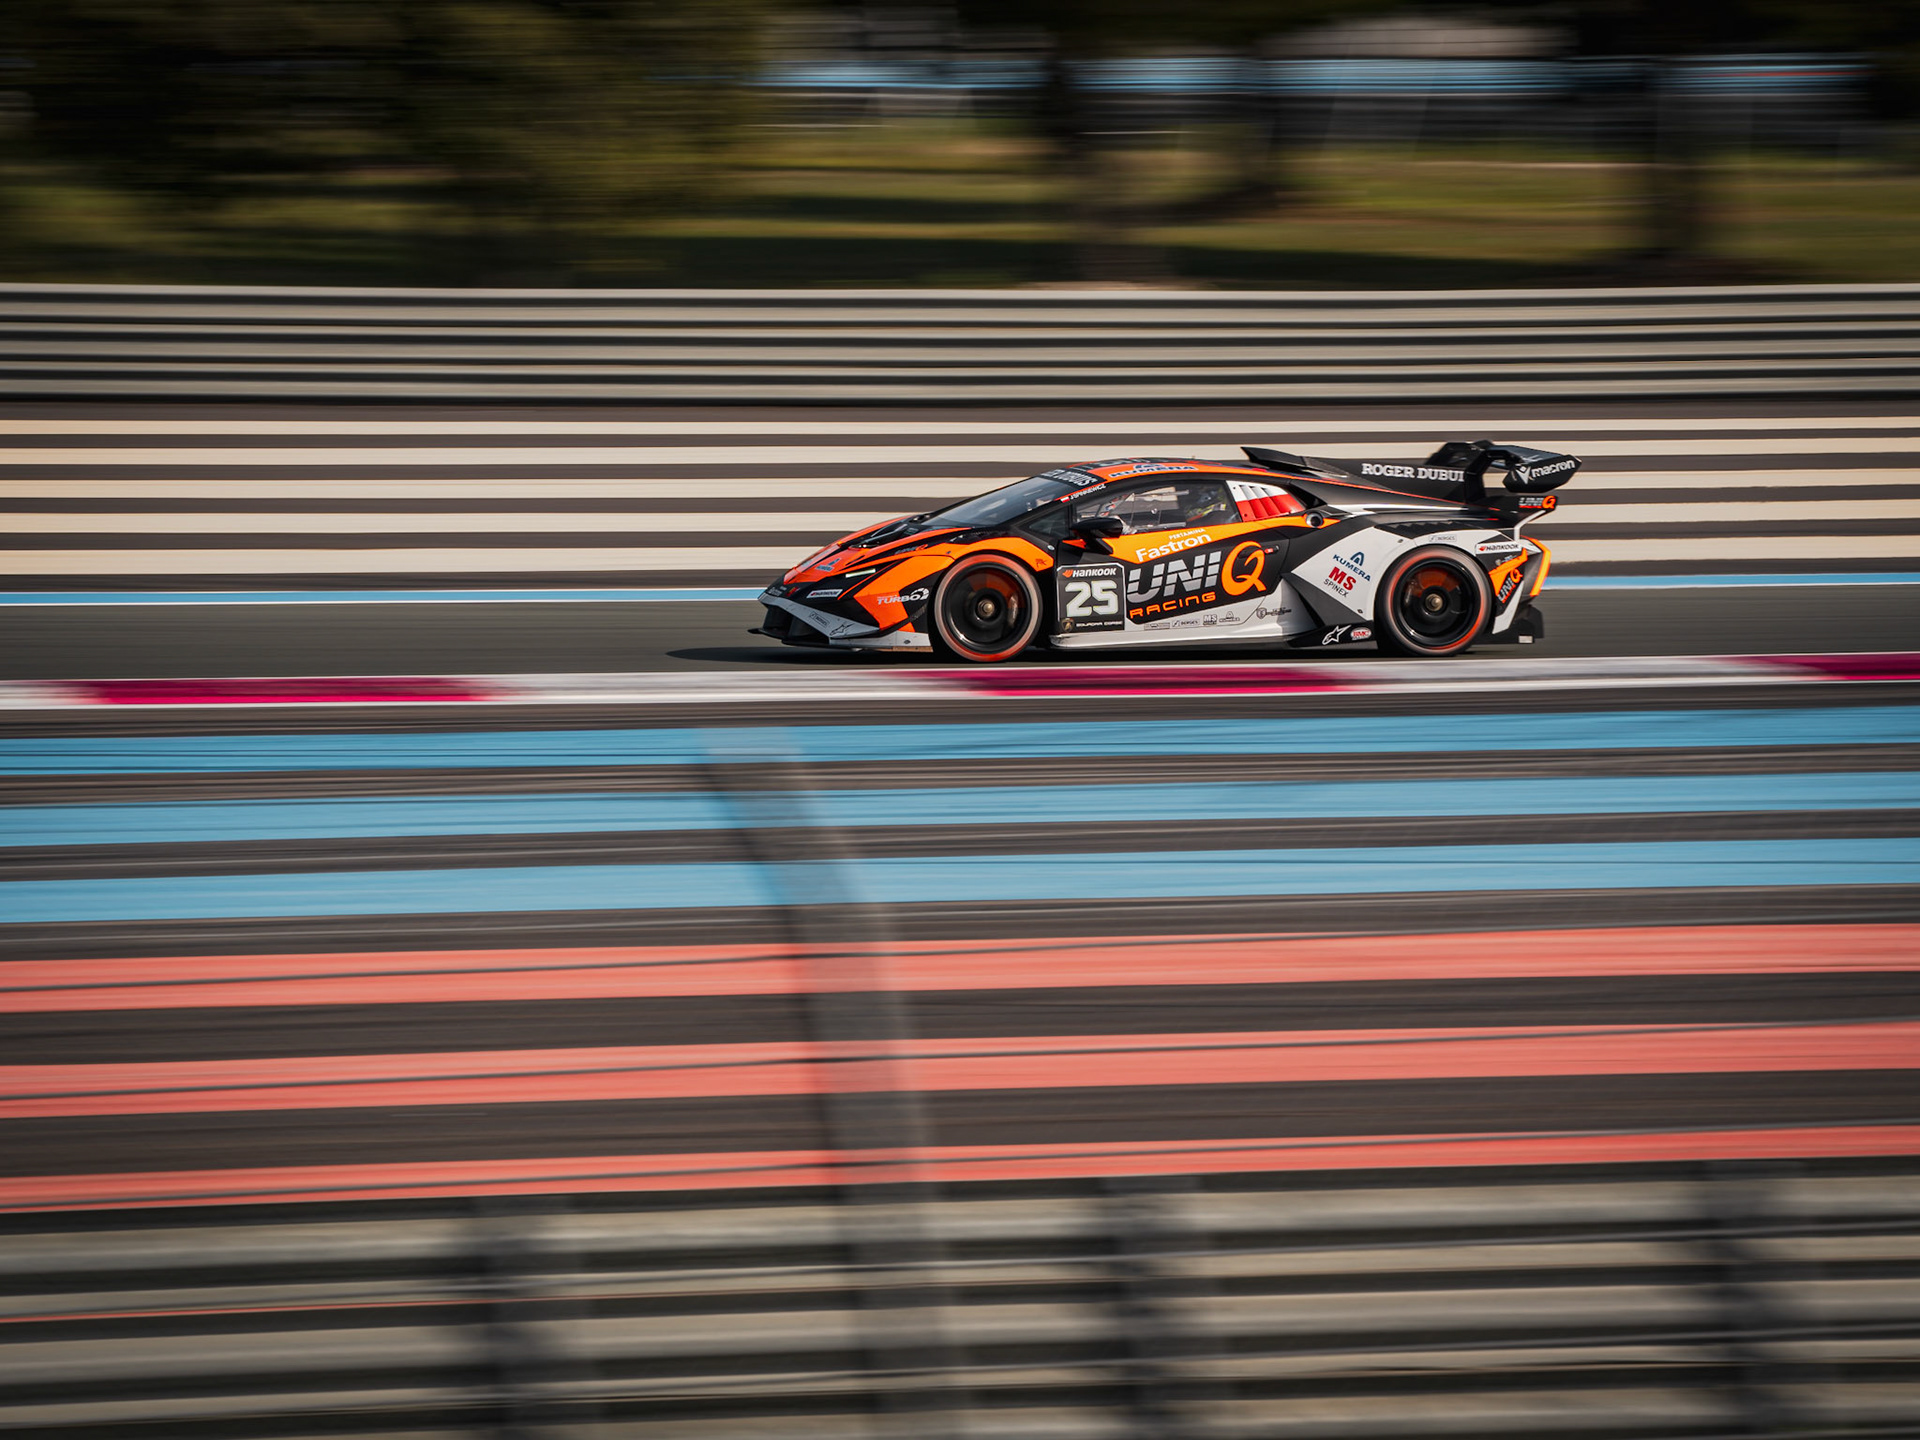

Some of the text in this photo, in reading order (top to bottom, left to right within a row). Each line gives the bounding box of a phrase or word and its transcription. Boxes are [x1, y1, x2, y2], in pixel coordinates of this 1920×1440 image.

[1361, 462, 1464, 483] ROGER DUBUI
[1531, 460, 1575, 478] macron
[1518, 495, 1557, 508] UNIQ
[1168, 528, 1206, 540] PERTAMINA
[1135, 533, 1213, 563] Fastron
[1126, 540, 1267, 604] UNIQ
[1328, 566, 1357, 591] MS
[1332, 554, 1372, 582] KUMERA
[1064, 579, 1119, 618] 25
[1323, 578, 1349, 598] SPINEX
[1129, 591, 1217, 619] RACING
